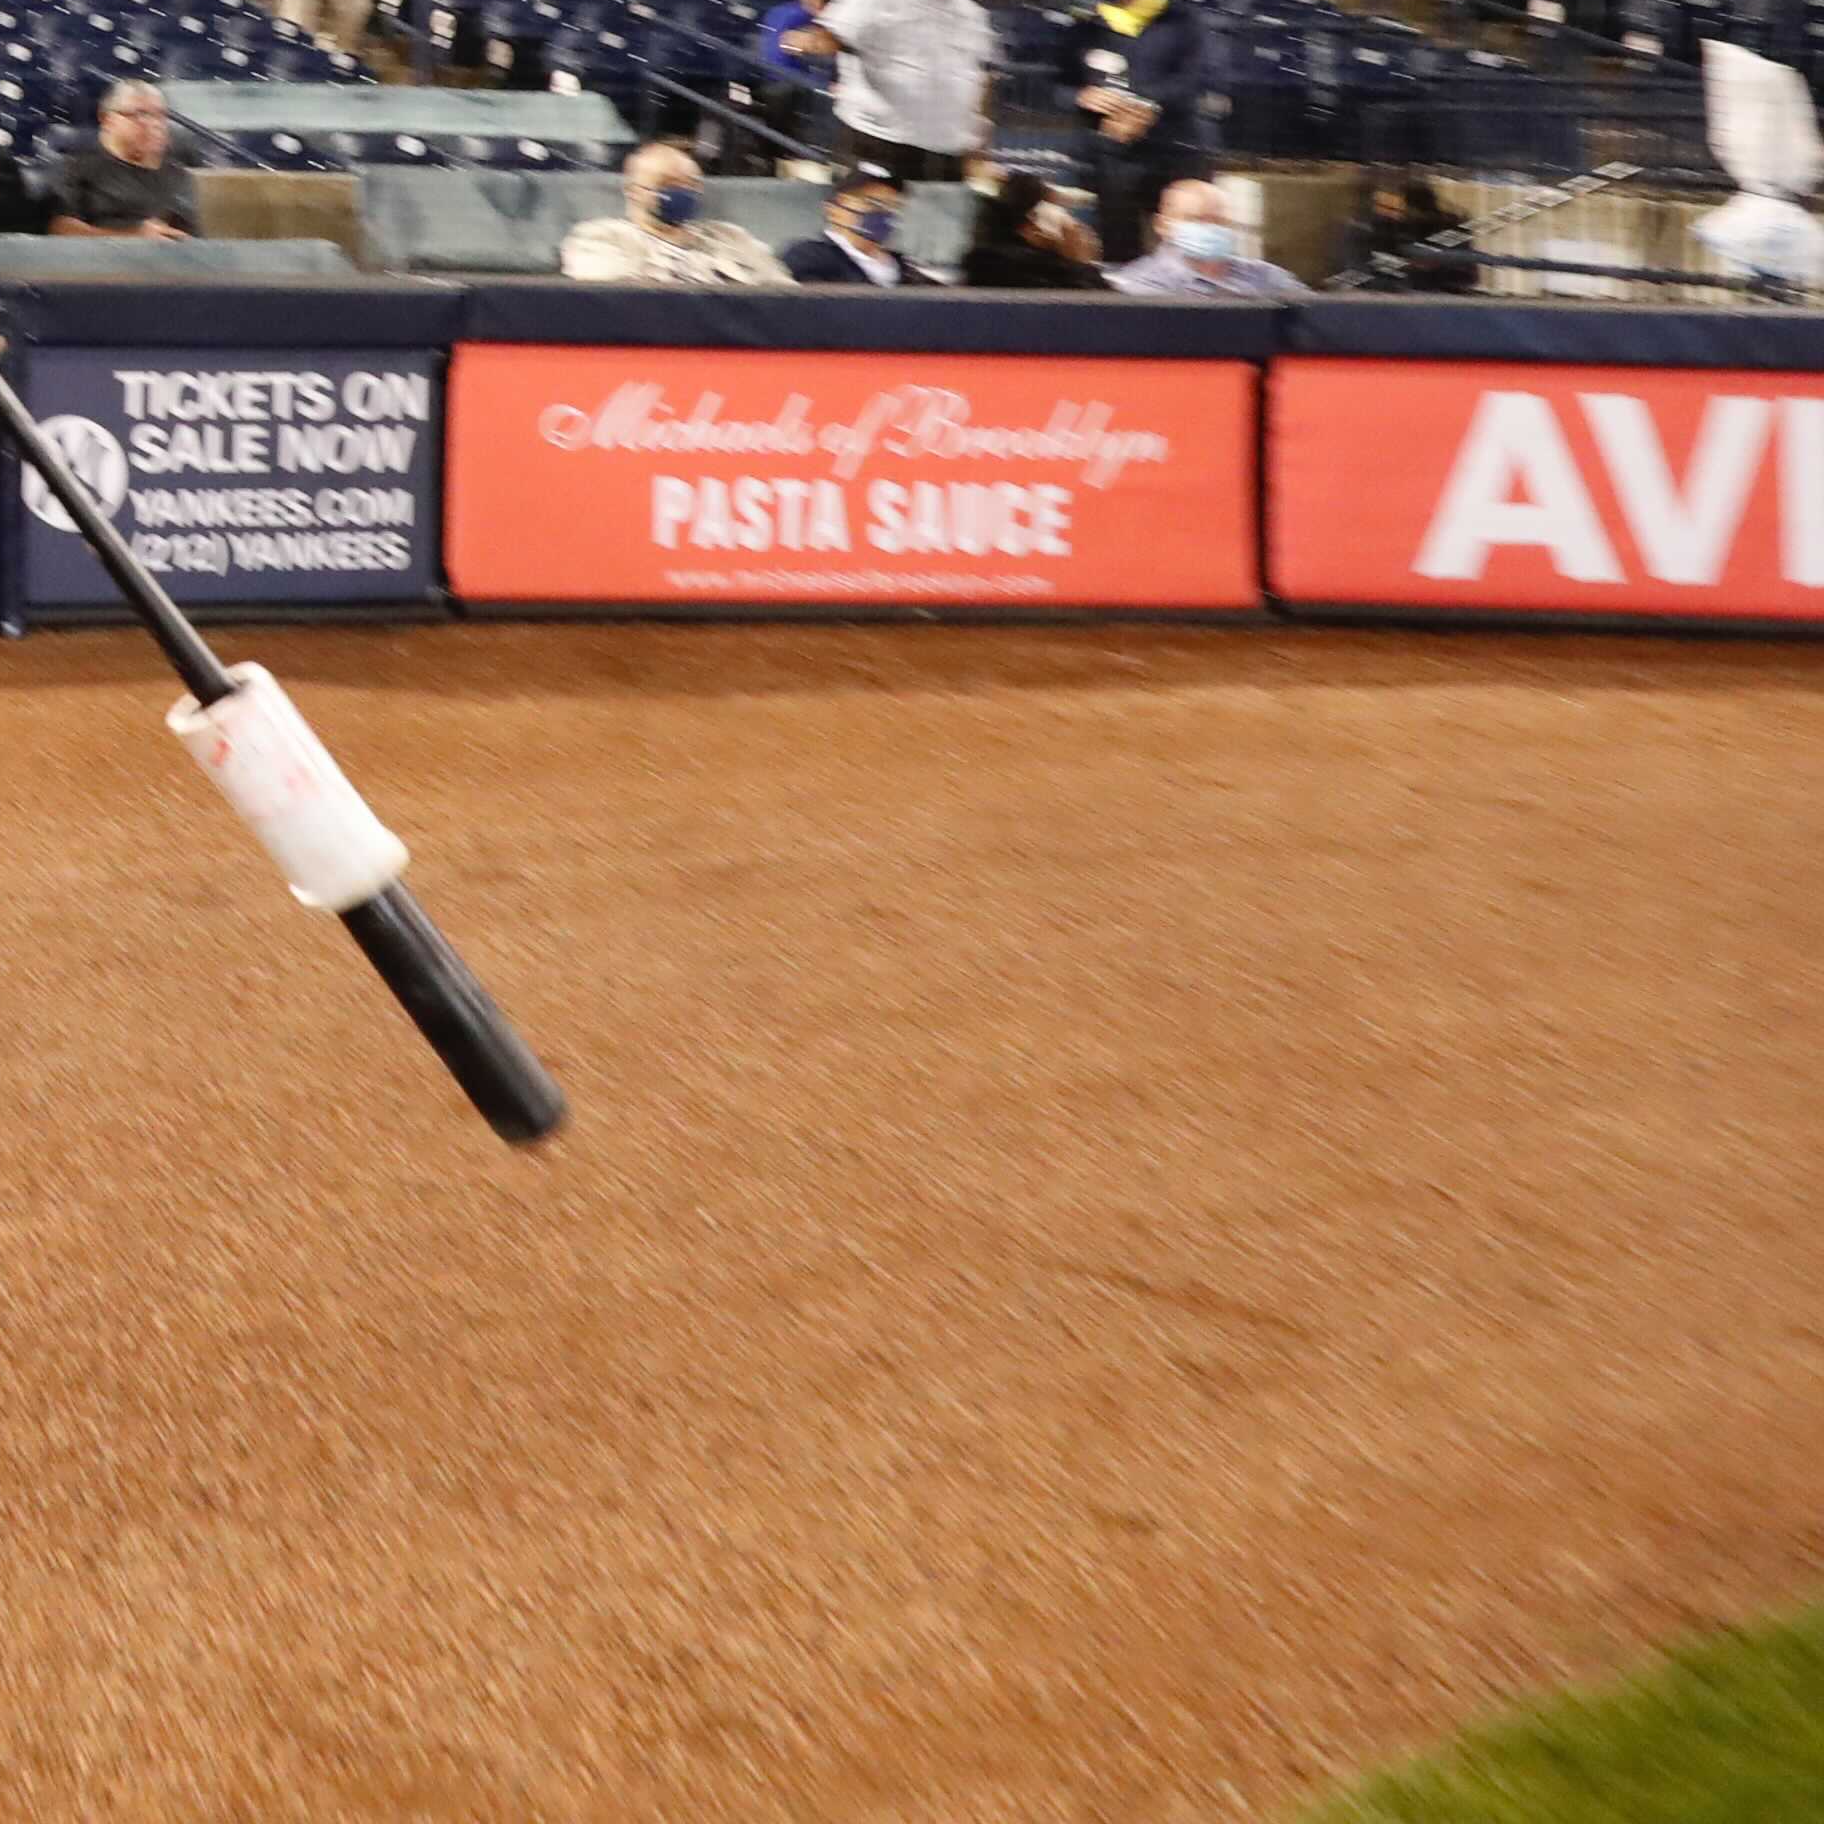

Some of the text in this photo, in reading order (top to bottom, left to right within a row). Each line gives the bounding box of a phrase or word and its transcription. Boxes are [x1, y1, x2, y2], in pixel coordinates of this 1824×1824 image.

[113, 370, 430, 422] TICKETS ON
[128, 423, 271, 474] SALE
[277, 423, 417, 474] NOW
[818, 391, 901, 480] of
[882, 383, 1169, 489] Brooklyn
[128, 487, 416, 528] YANKEES.COM
[652, 475, 1074, 557] PASTA SAUCE
[224, 531, 412, 572] YANKEES
